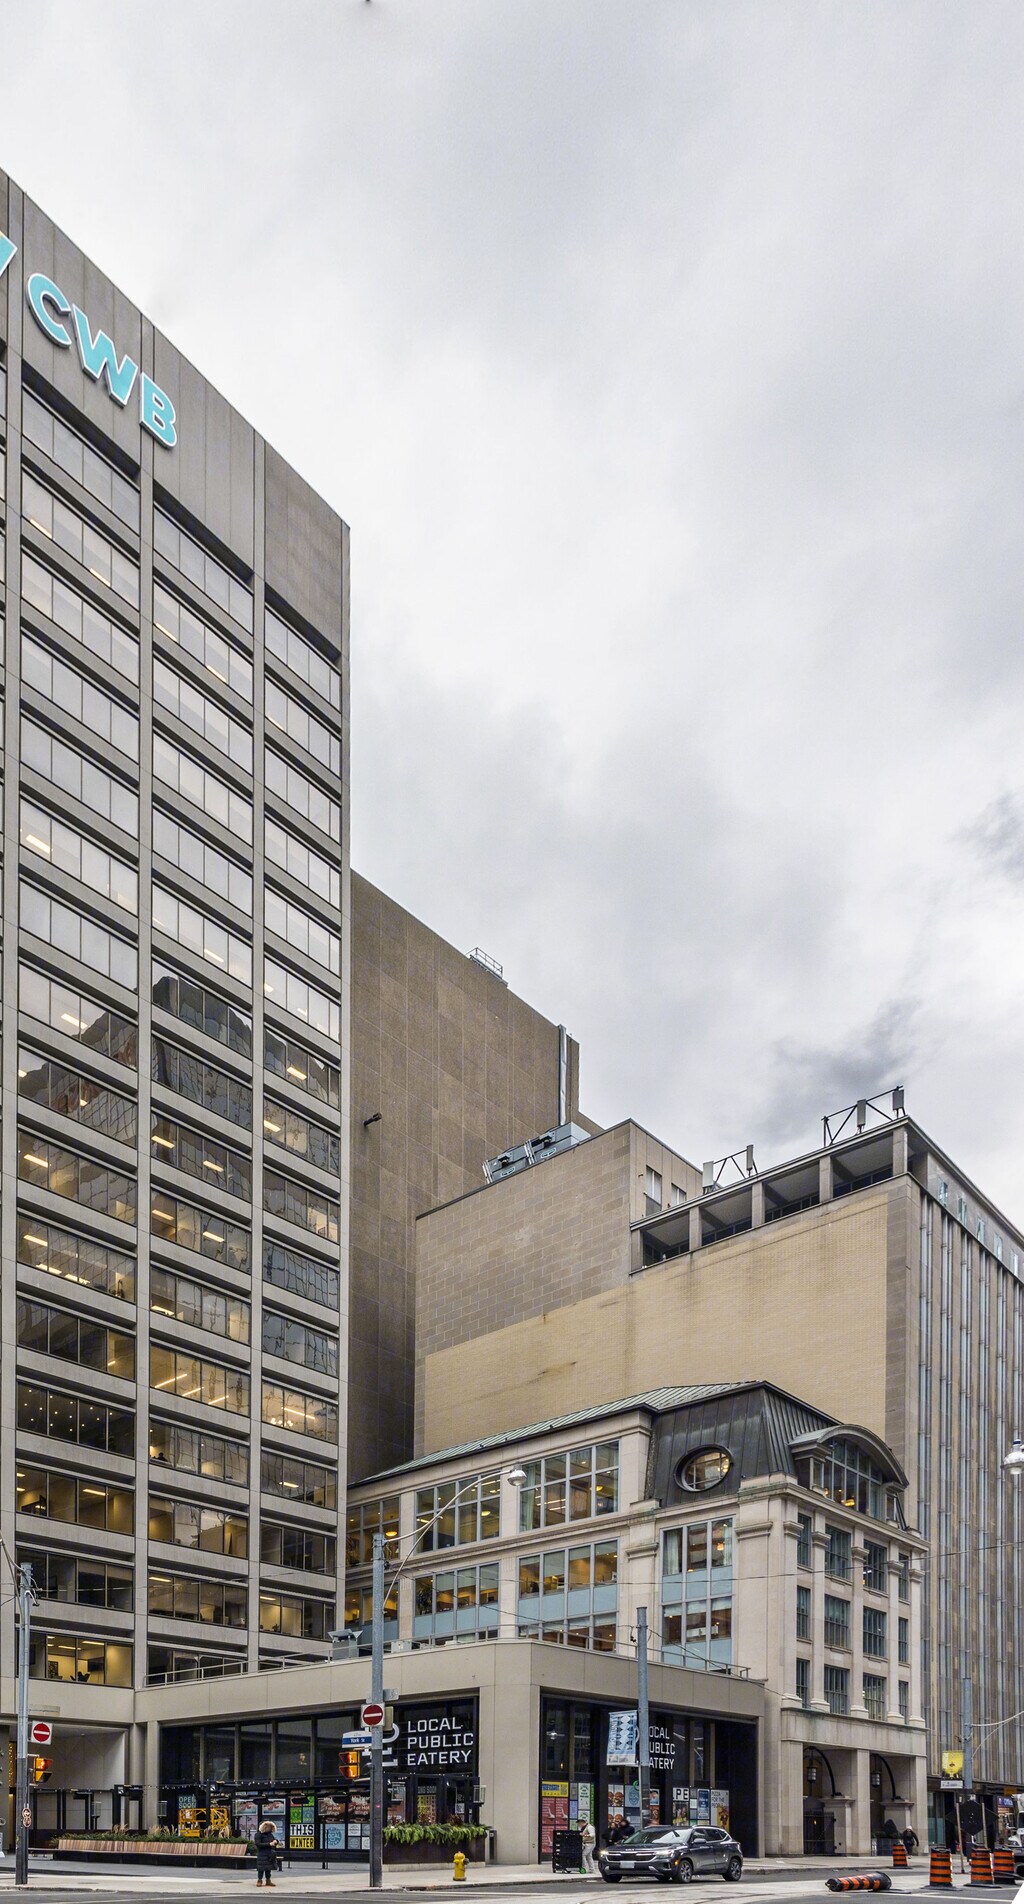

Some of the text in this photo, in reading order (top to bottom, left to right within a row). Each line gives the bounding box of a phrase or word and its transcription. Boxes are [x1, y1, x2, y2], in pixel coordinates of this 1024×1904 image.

[26, 273, 178, 449] CWB
[407, 1717, 462, 1733] LOCAL
[649, 1726, 670, 1739] OCAL
[407, 1733, 474, 1750] PUBLIC
[649, 1741, 676, 1755] UBLIC
[407, 1750, 472, 1766] EATERY
[649, 1757, 675, 1770] ATERY
[673, 1788, 689, 1800] PE
[290, 1824, 314, 1836] THIS
[290, 1837, 314, 1848] WINTER
